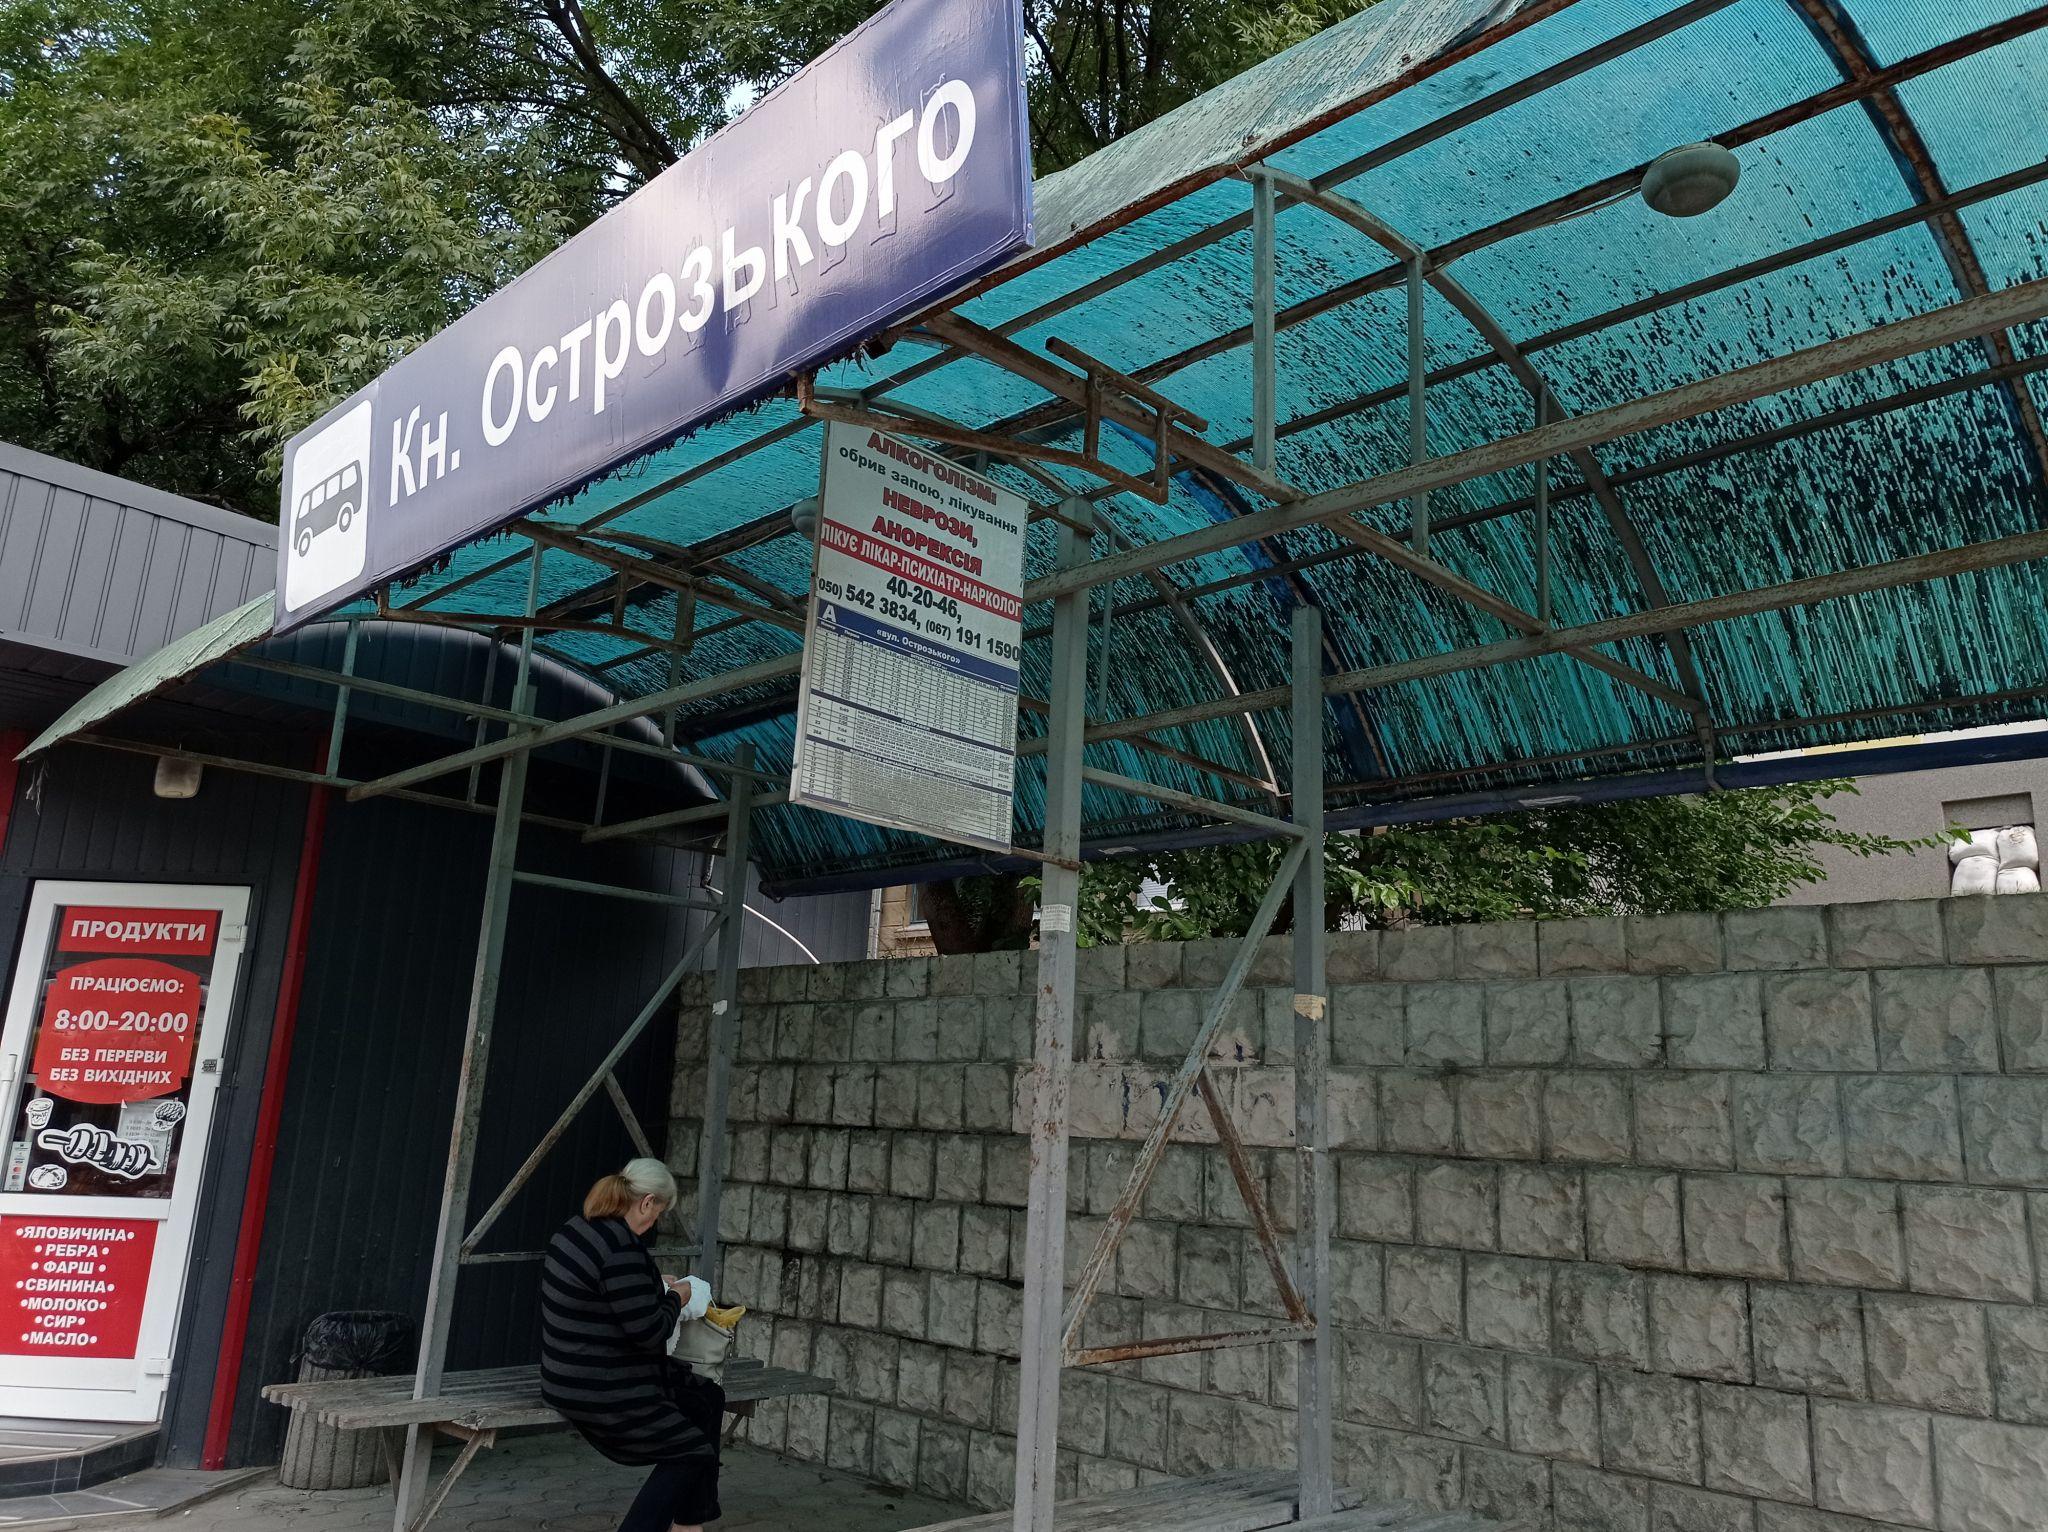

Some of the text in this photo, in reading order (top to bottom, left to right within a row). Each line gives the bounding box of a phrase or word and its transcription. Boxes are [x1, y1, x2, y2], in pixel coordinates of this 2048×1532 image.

[389, 78, 977, 508] Кн. Острозького
[839, 446, 1018, 536] обрив запою, лікування
[882, 486, 978, 549] НЕВРОЗИ,
[871, 515, 983, 577] АНОРЕКСІЯ
[821, 524, 1022, 618] ЛІКУЄ ЛІКАР-ПСИХІАТР-НАРКОЛОГ
[886, 575, 962, 625] 40-20-46,
[817, 577, 1021, 662] 050) 542 3834, (067) 191 1590
[822, 604, 838, 624] А
[876, 629, 901, 644] «вул.
[902, 637, 961, 664] Острозького»
[71, 920, 206, 943] ПРОДУКТИ
[70, 976, 185, 994] ПРАЦЮЄМО:
[54, 1009, 189, 1033] 8:00-20:00
[60, 1047, 168, 1064] БЕЗ ПЕРЕРВИ
[49, 1067, 172, 1086] БЕЗ ВИХІДНИХ
[23, 1225, 127, 1242] ЯЛОВИЧИНА
[44, 1243, 98, 1258] РЕБРА
[43, 1260, 95, 1275] ФАРШ
[25, 1277, 106, 1294] СВИНИНА
[28, 1297, 99, 1312] МОЛОКО
[43, 1314, 78, 1328] СИР
[29, 1331, 90, 1347] МАСЛО
